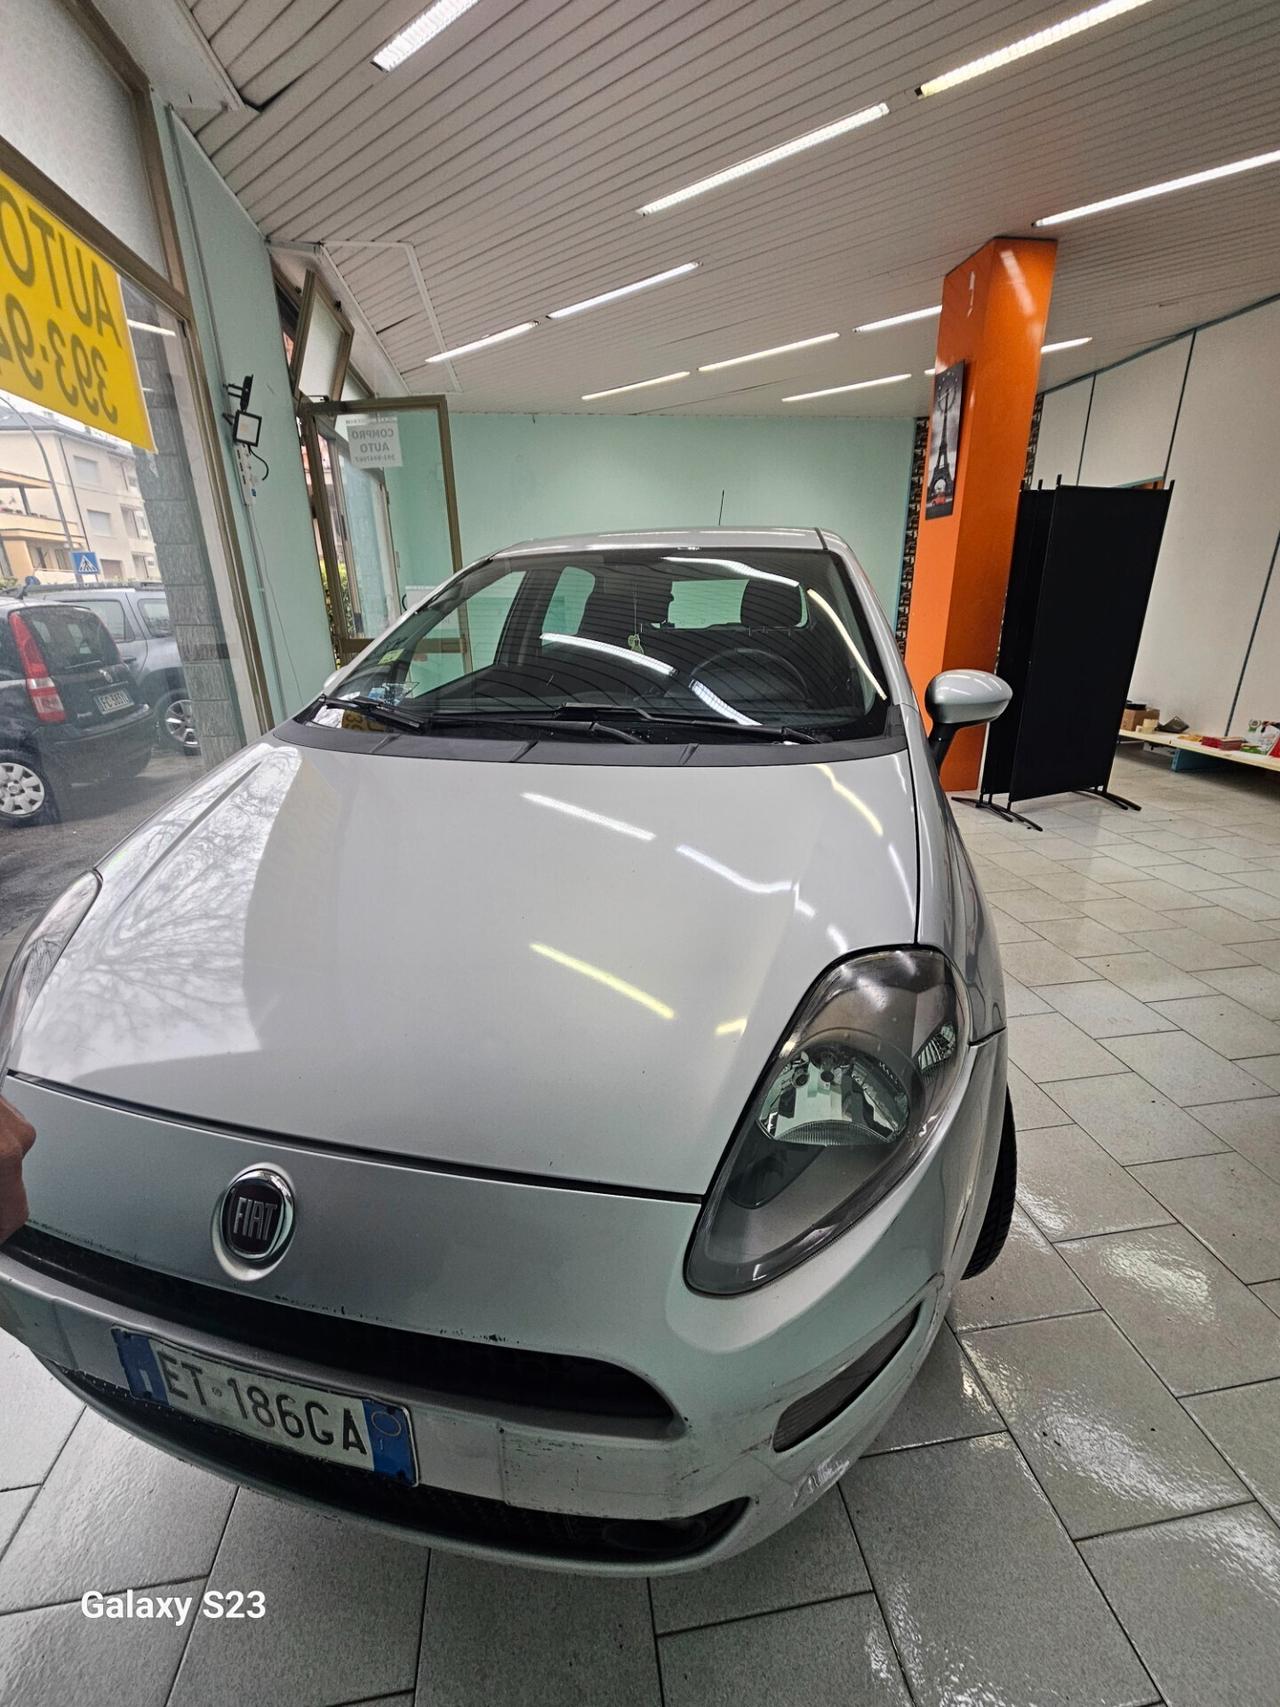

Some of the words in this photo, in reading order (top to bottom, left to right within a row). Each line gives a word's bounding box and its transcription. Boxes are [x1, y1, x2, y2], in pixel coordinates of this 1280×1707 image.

[233, 1196, 278, 1241] FIAT
[155, 1351, 206, 1406] ET
[227, 1377, 368, 1455] 186GA
